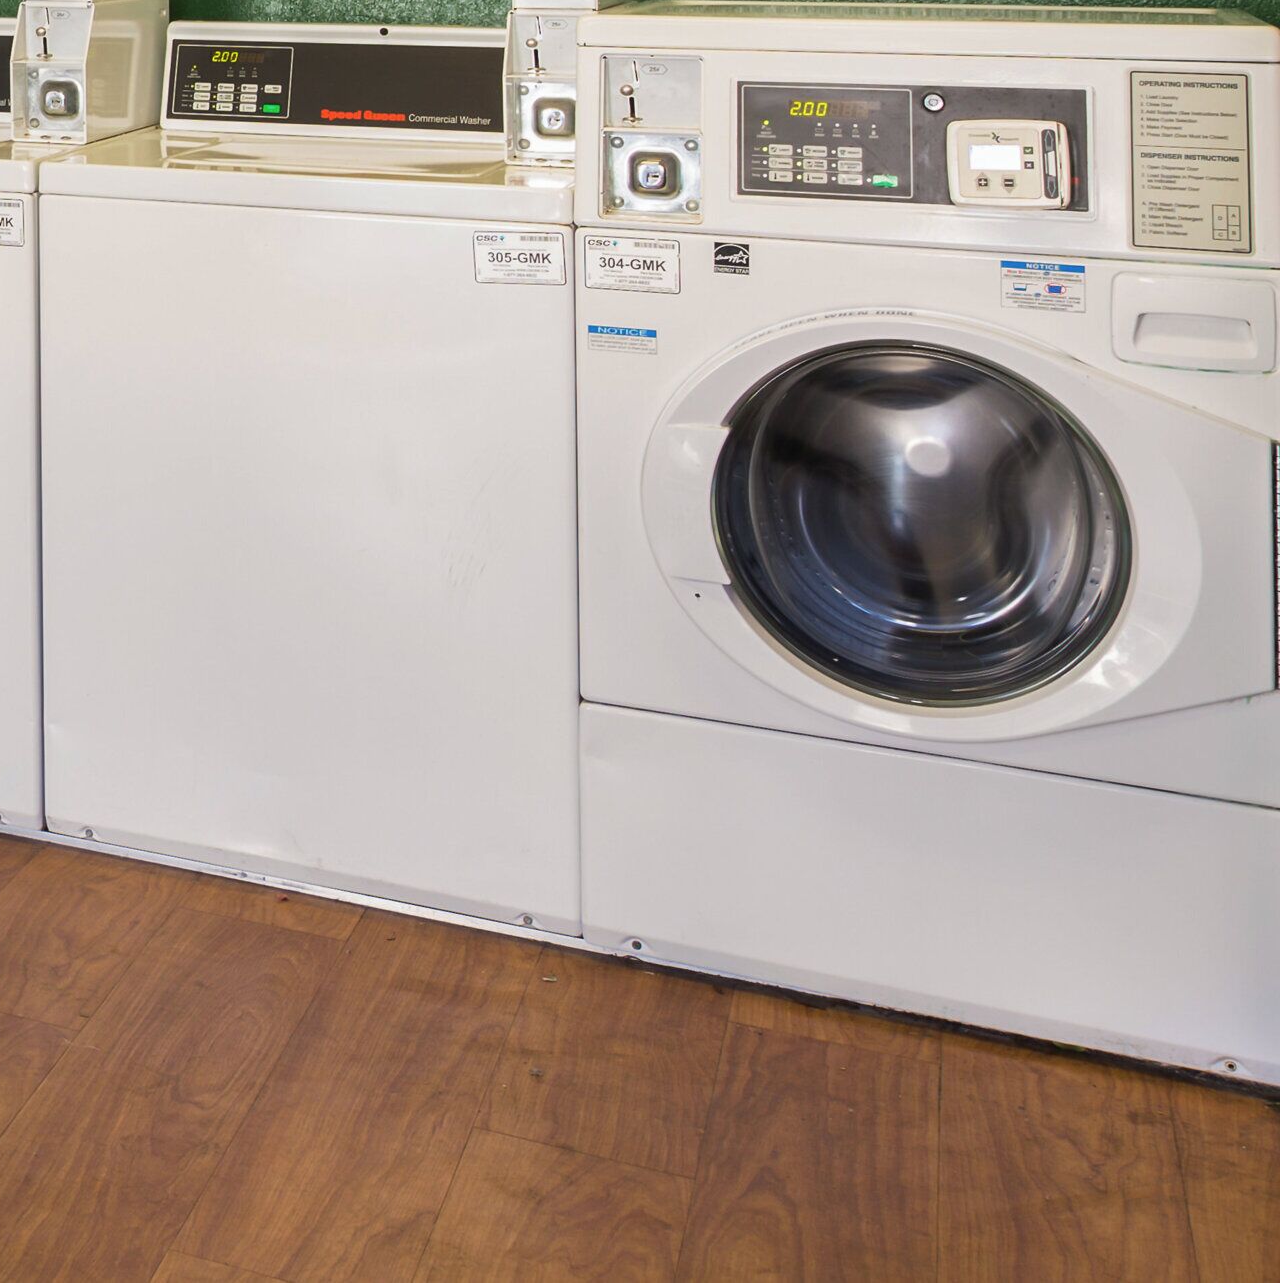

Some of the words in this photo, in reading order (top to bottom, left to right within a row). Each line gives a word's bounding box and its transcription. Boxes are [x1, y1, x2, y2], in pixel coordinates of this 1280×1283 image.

[212, 51, 238, 62] 2.00
[1139, 80, 1182, 88] OPERATING
[1183, 81, 1239, 89] INSTRUCTIONS
[790, 101, 828, 117] 2.00
[320, 109, 362, 121] Speed
[408, 113, 458, 124] Commercial
[460, 115, 491, 126] Washer
[1140, 152, 1182, 160] DISPENSER
[1184, 153, 1240, 162] INSTRUCTIONS
[476, 234, 498, 242] CSC
[587, 239, 611, 247] CSC
[488, 252, 552, 264] 305-GMK
[599, 256, 666, 272] 304-GMK
[1026, 263, 1060, 271] NOTICE
[597, 325, 648, 337] NOTICE
